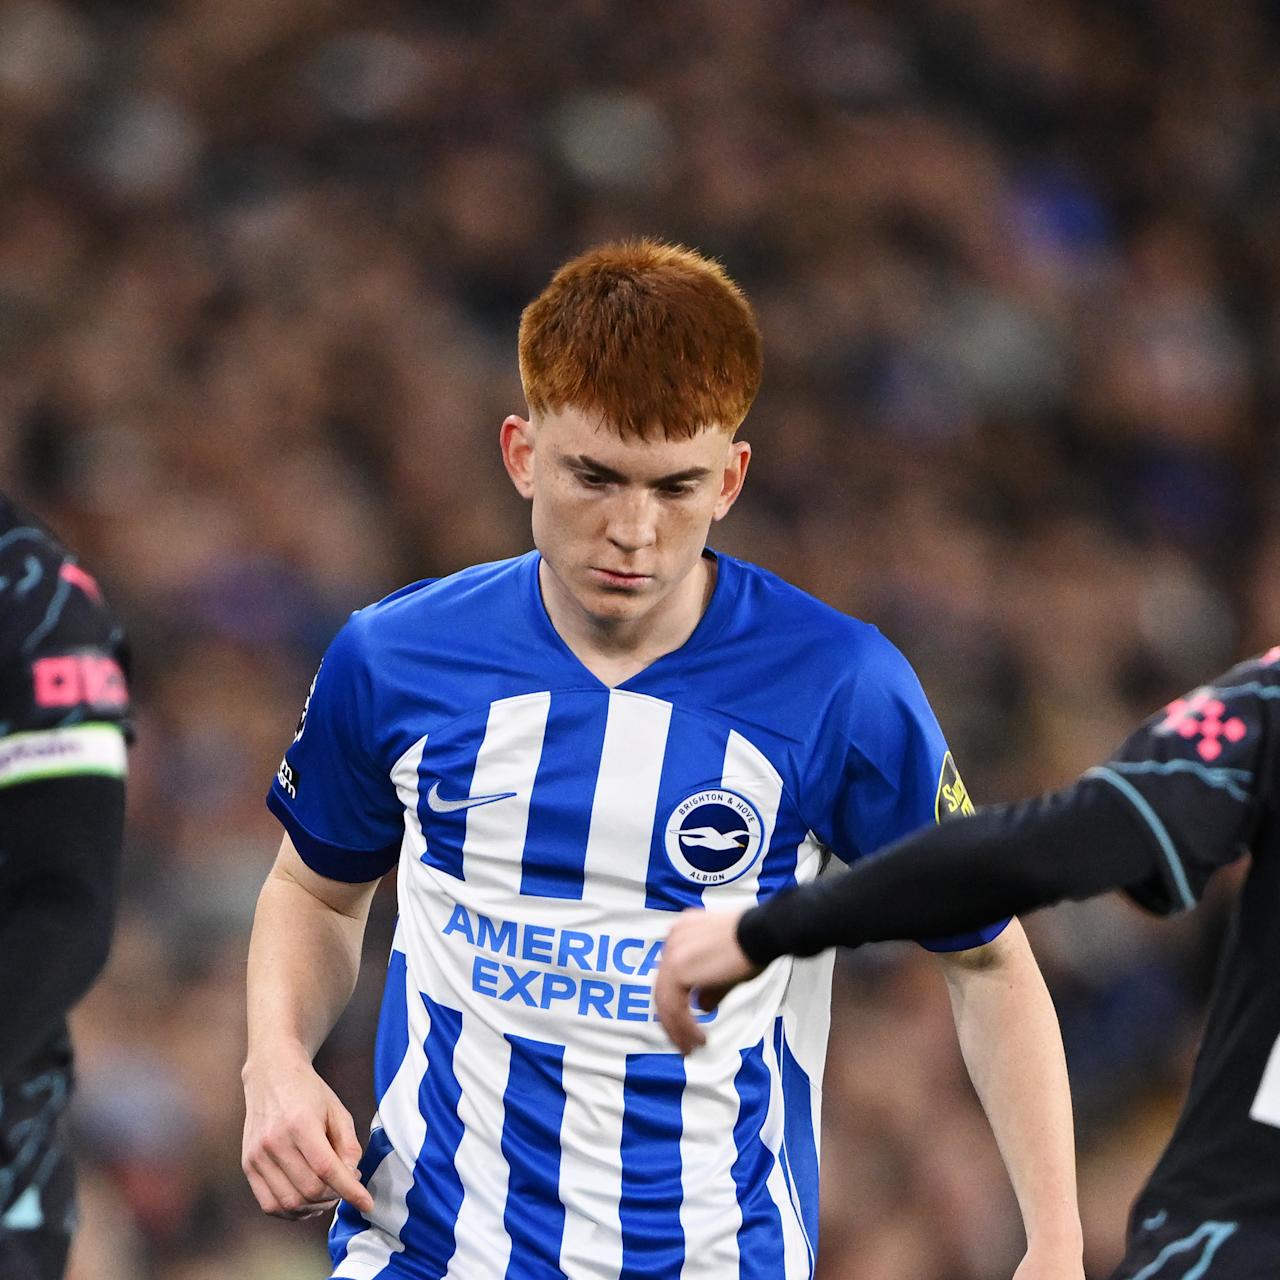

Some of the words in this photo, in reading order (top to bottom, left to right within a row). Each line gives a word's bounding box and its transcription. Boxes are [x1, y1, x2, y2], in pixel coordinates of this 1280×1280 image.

[678, 793, 724, 815] BRIGHTON
[736, 802, 756, 823] HOVE
[689, 871, 726, 882] ALBION
[442, 902, 667, 977] AMERICA
